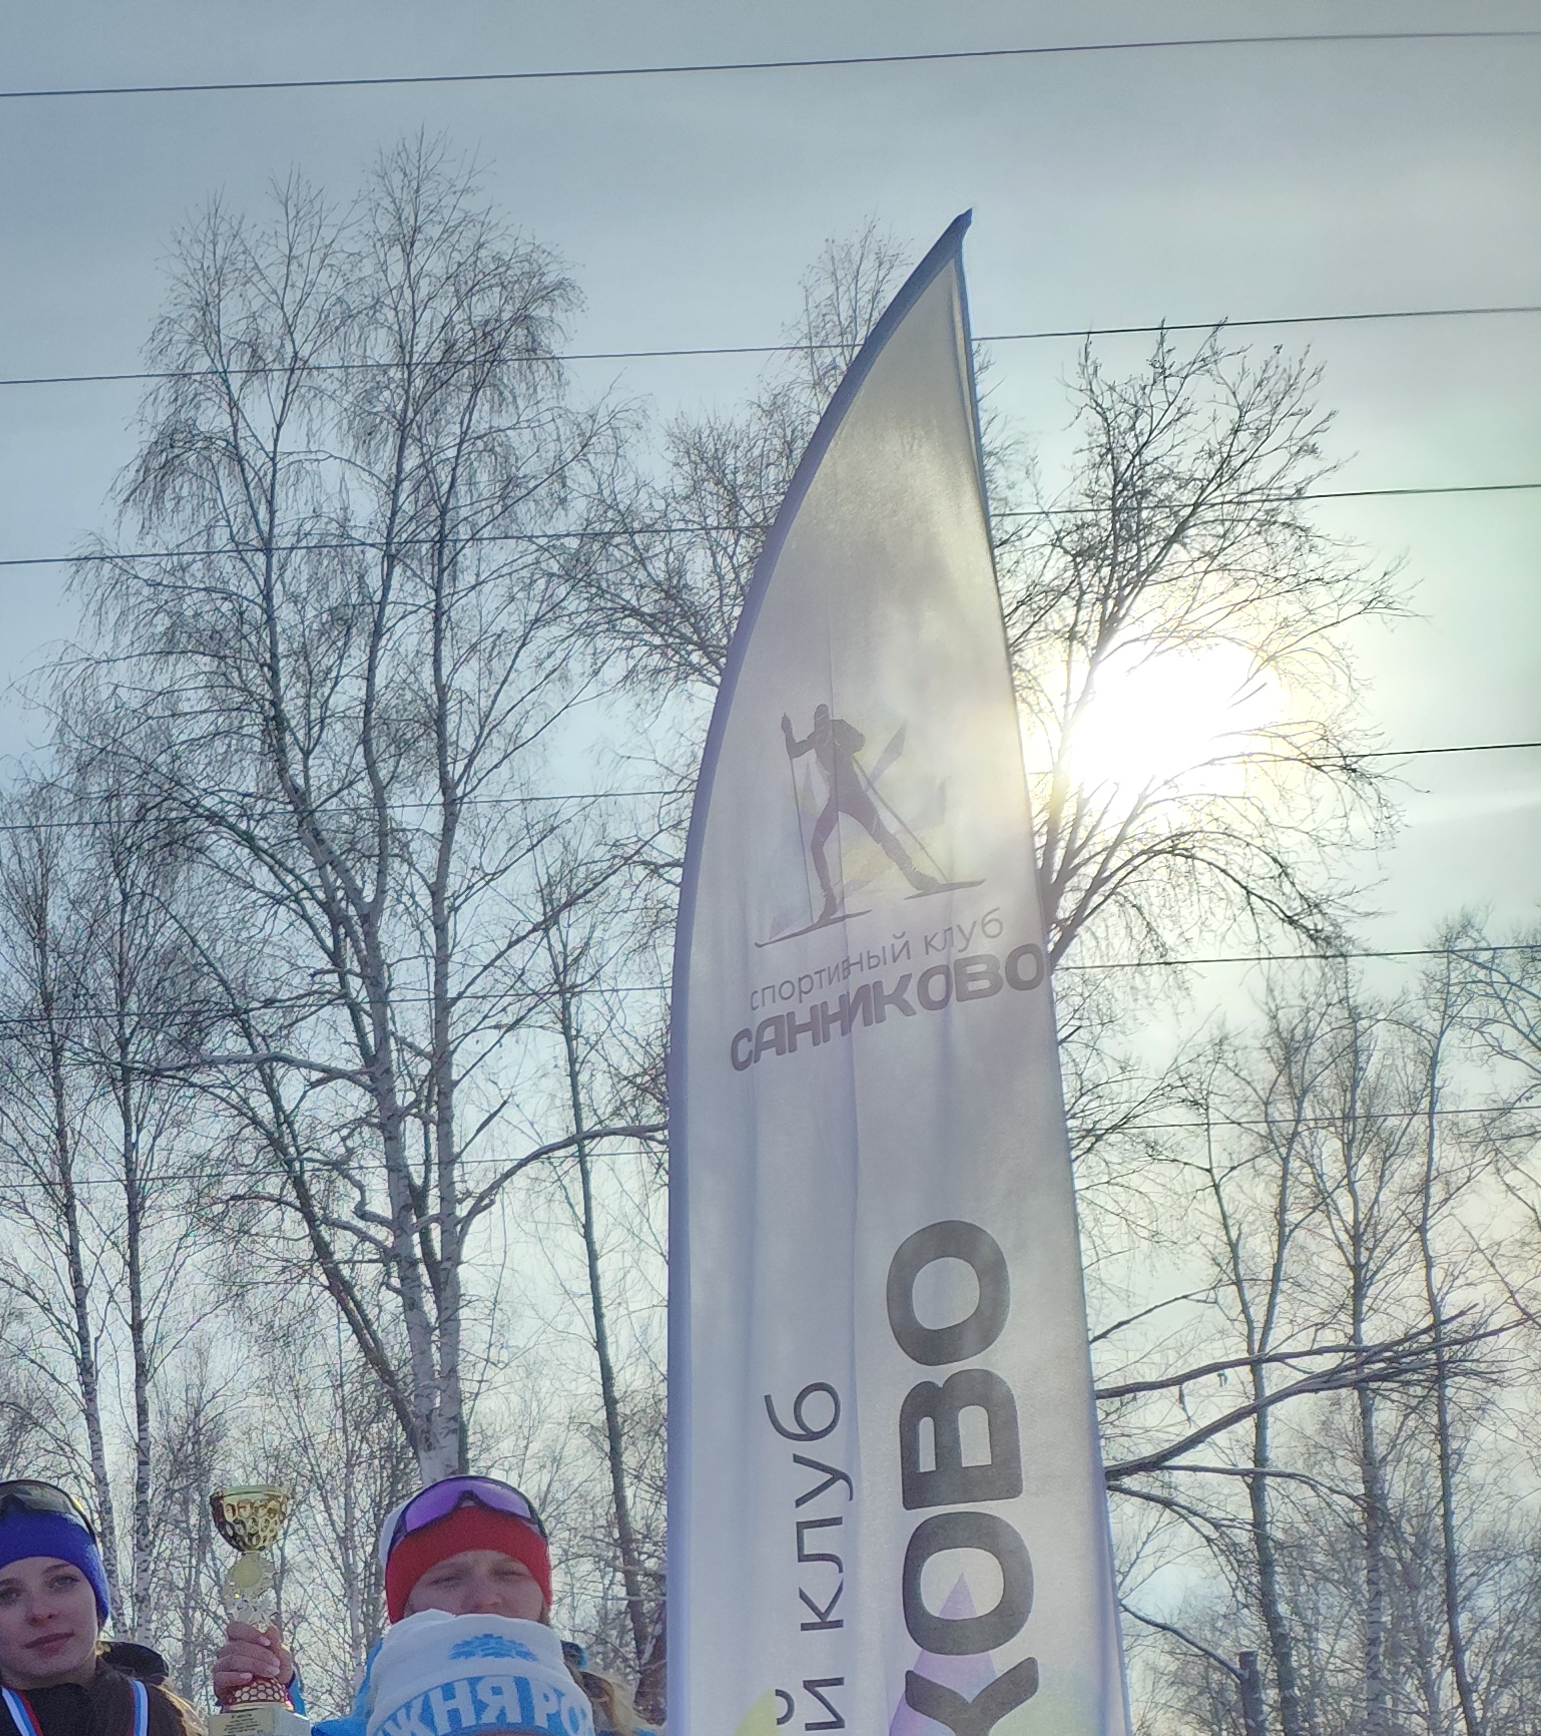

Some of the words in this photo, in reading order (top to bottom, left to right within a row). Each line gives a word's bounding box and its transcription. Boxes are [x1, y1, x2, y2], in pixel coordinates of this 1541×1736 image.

[730, 943, 1045, 1071] САННИКОВО
[750, 931, 911, 1011] спортивный
[924, 906, 1004, 956] клуб
[764, 1381, 853, 1632] клуб
